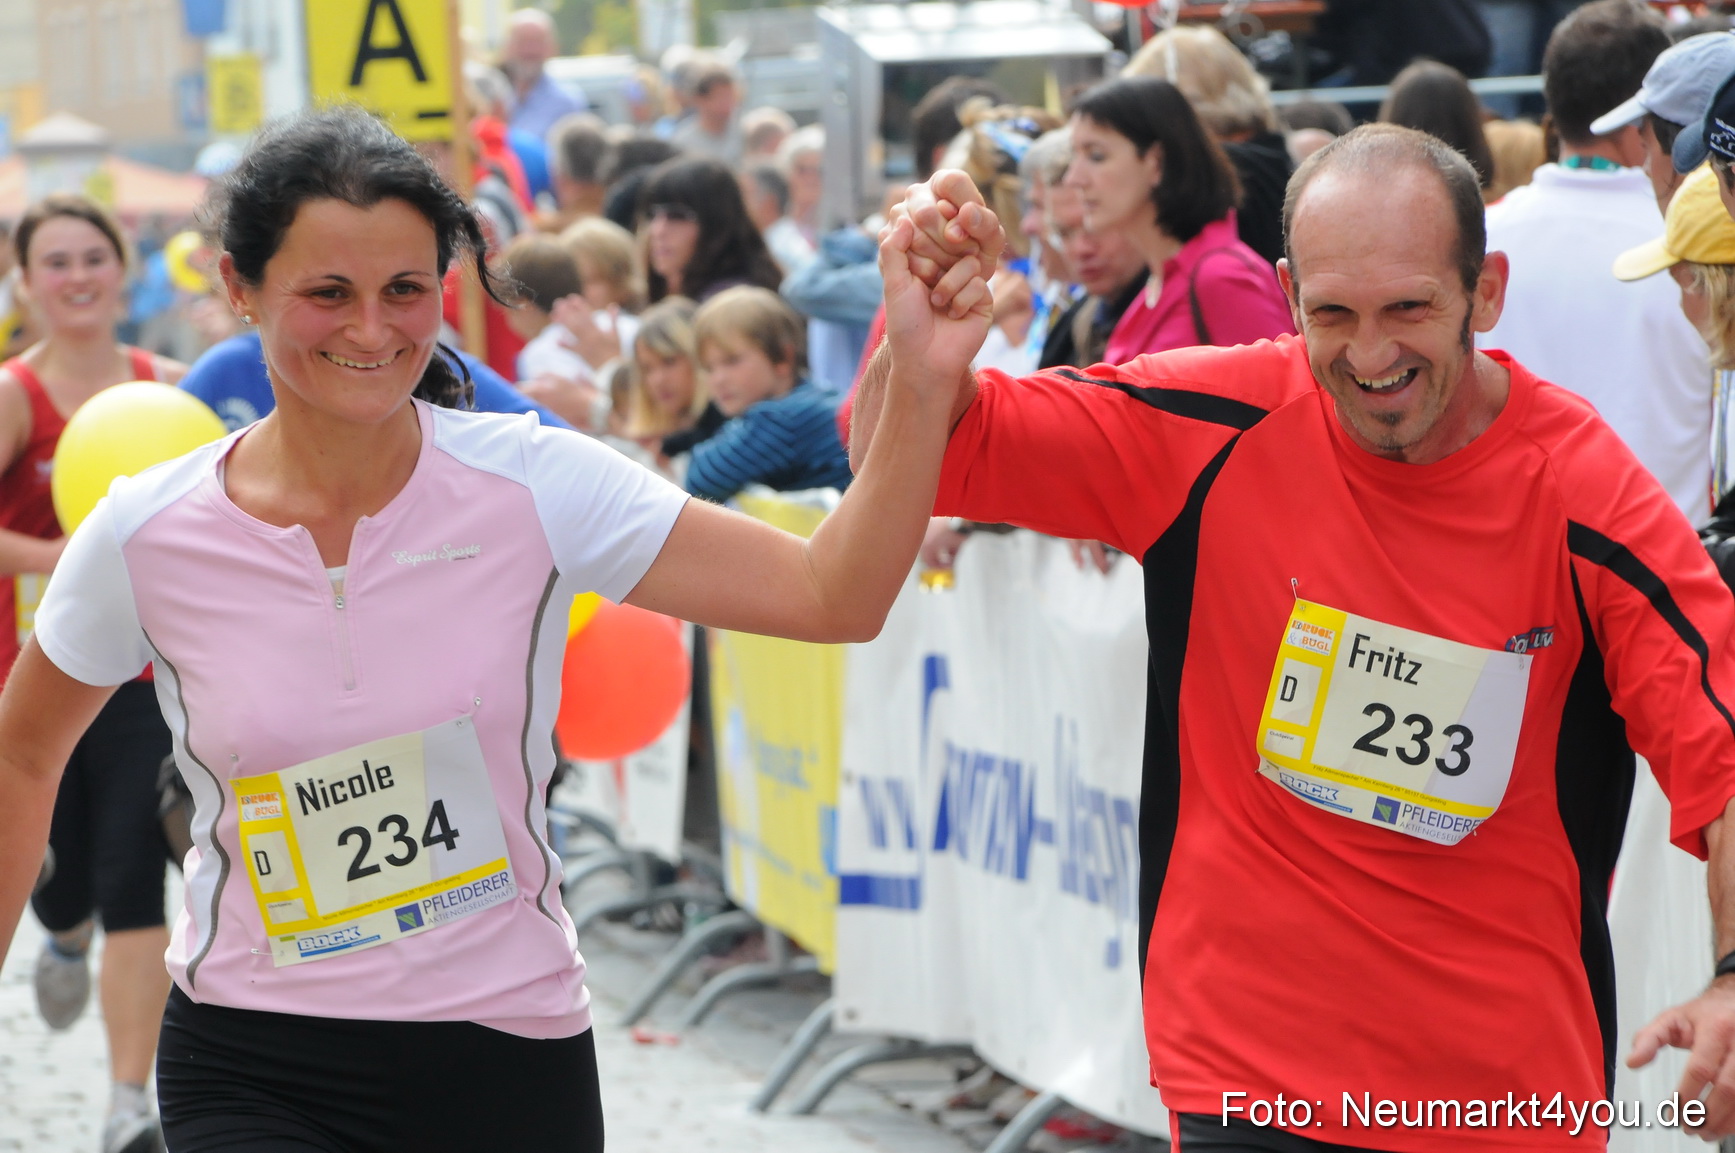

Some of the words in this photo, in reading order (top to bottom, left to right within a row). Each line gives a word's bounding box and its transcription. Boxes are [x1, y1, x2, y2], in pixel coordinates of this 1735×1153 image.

[350, 0, 428, 86] A
[391, 550, 437, 567] Esprit
[439, 543, 481, 562] Sports
[1301, 636, 1330, 652] BÜGL
[1348, 633, 1423, 686] Fritz
[1280, 675, 1298, 702] D
[1352, 702, 1474, 777] 233
[295, 760, 395, 816] Nicole
[1279, 772, 1339, 801] BOCK
[337, 799, 460, 882] 234
[254, 850, 272, 876] D
[422, 871, 510, 915] PFLEIDERER
[428, 887, 514, 925] AKTIENGESELLSCHAFT
[297, 926, 361, 951] BOCK
